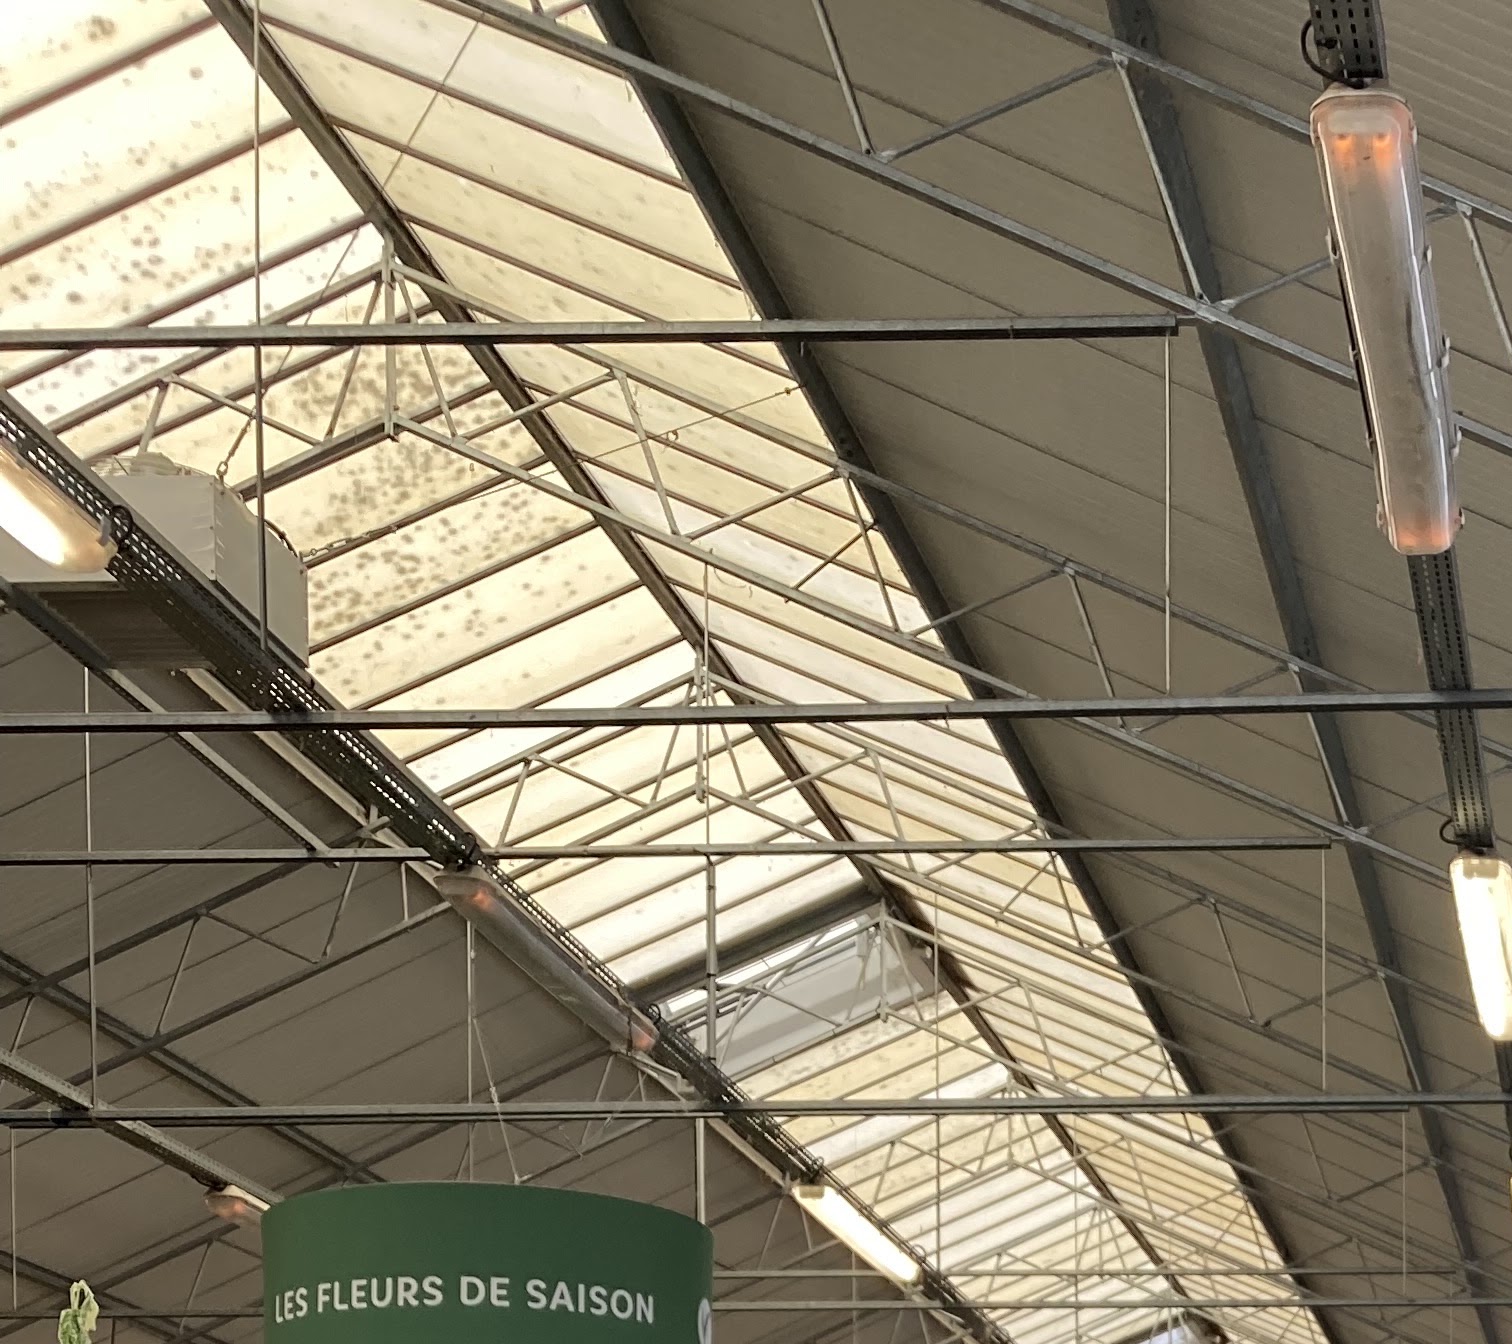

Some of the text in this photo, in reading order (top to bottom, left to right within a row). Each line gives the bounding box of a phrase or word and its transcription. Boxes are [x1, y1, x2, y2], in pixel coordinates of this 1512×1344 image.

[275, 1274, 655, 1325] LES FLEURS DE SAISON
